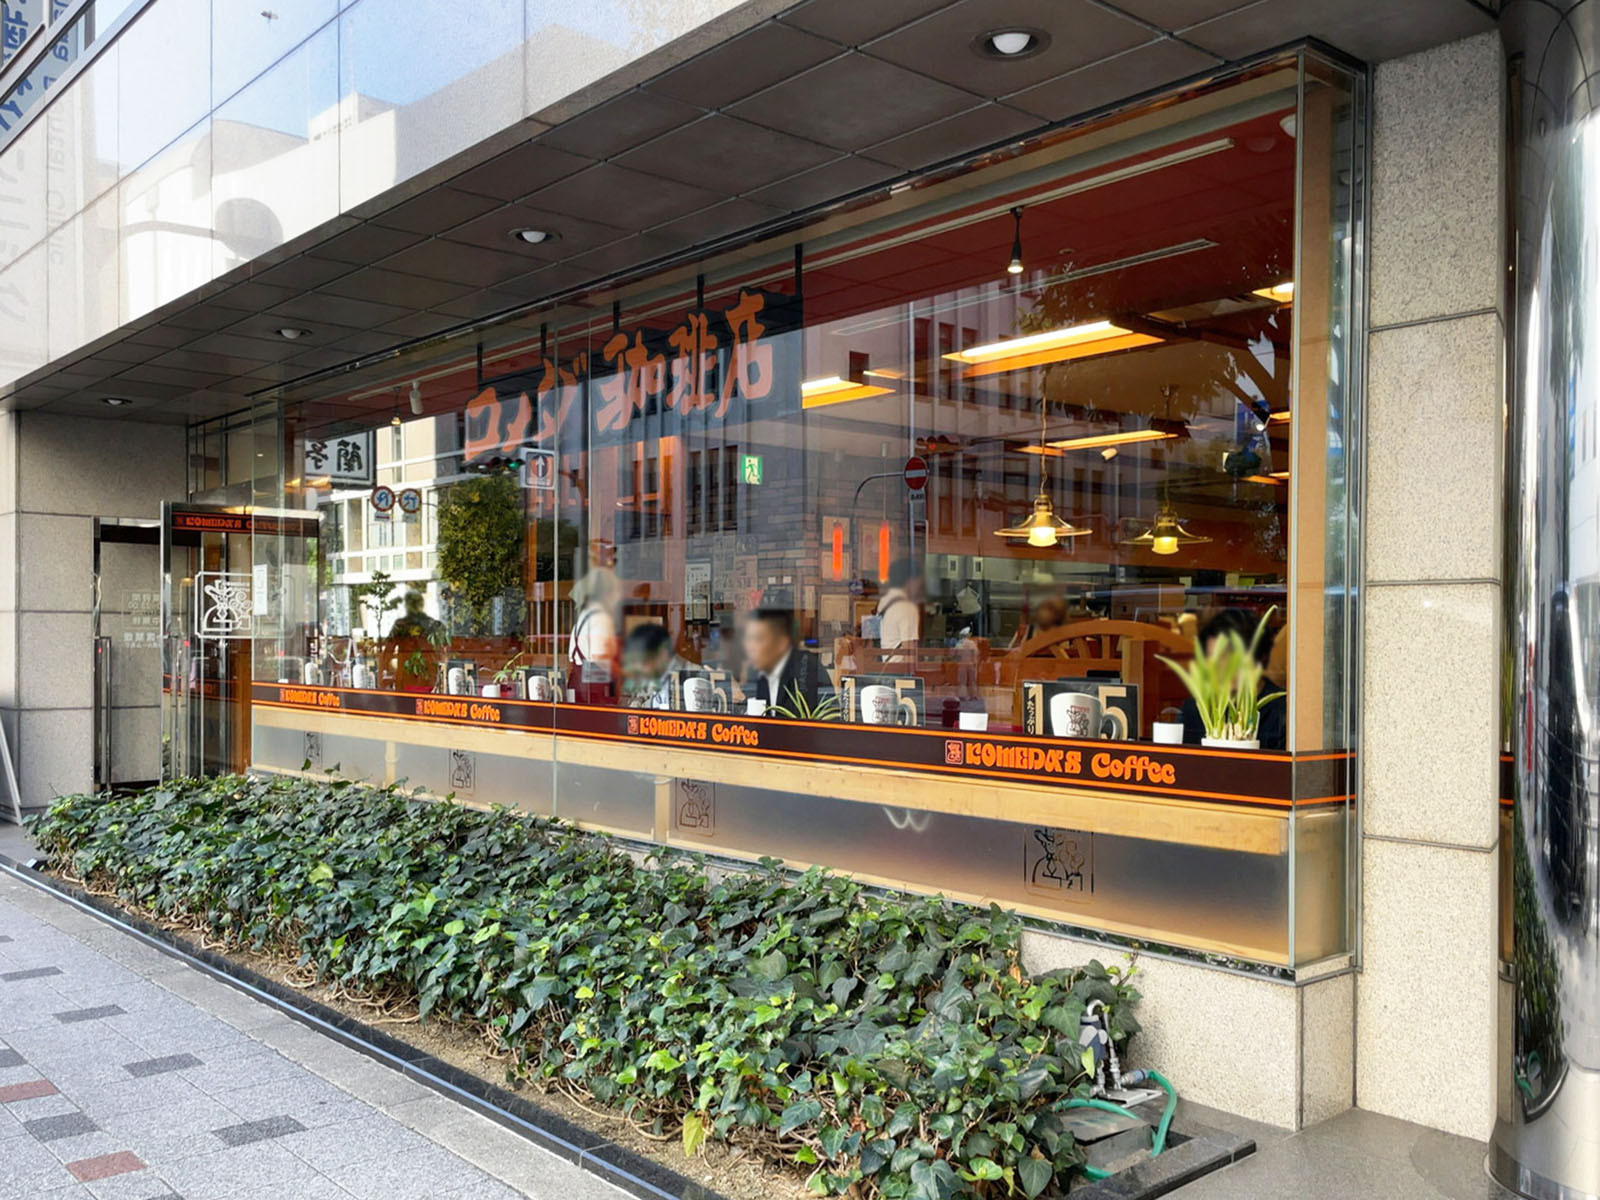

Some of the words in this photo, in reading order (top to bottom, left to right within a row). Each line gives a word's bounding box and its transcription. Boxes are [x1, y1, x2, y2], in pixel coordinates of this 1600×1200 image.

[640, 717, 707, 740] KOMEDA'S
[711, 723, 759, 746] Coffee
[965, 742, 1081, 774] KOMEDA'S
[1091, 752, 1176, 784] Coffee
